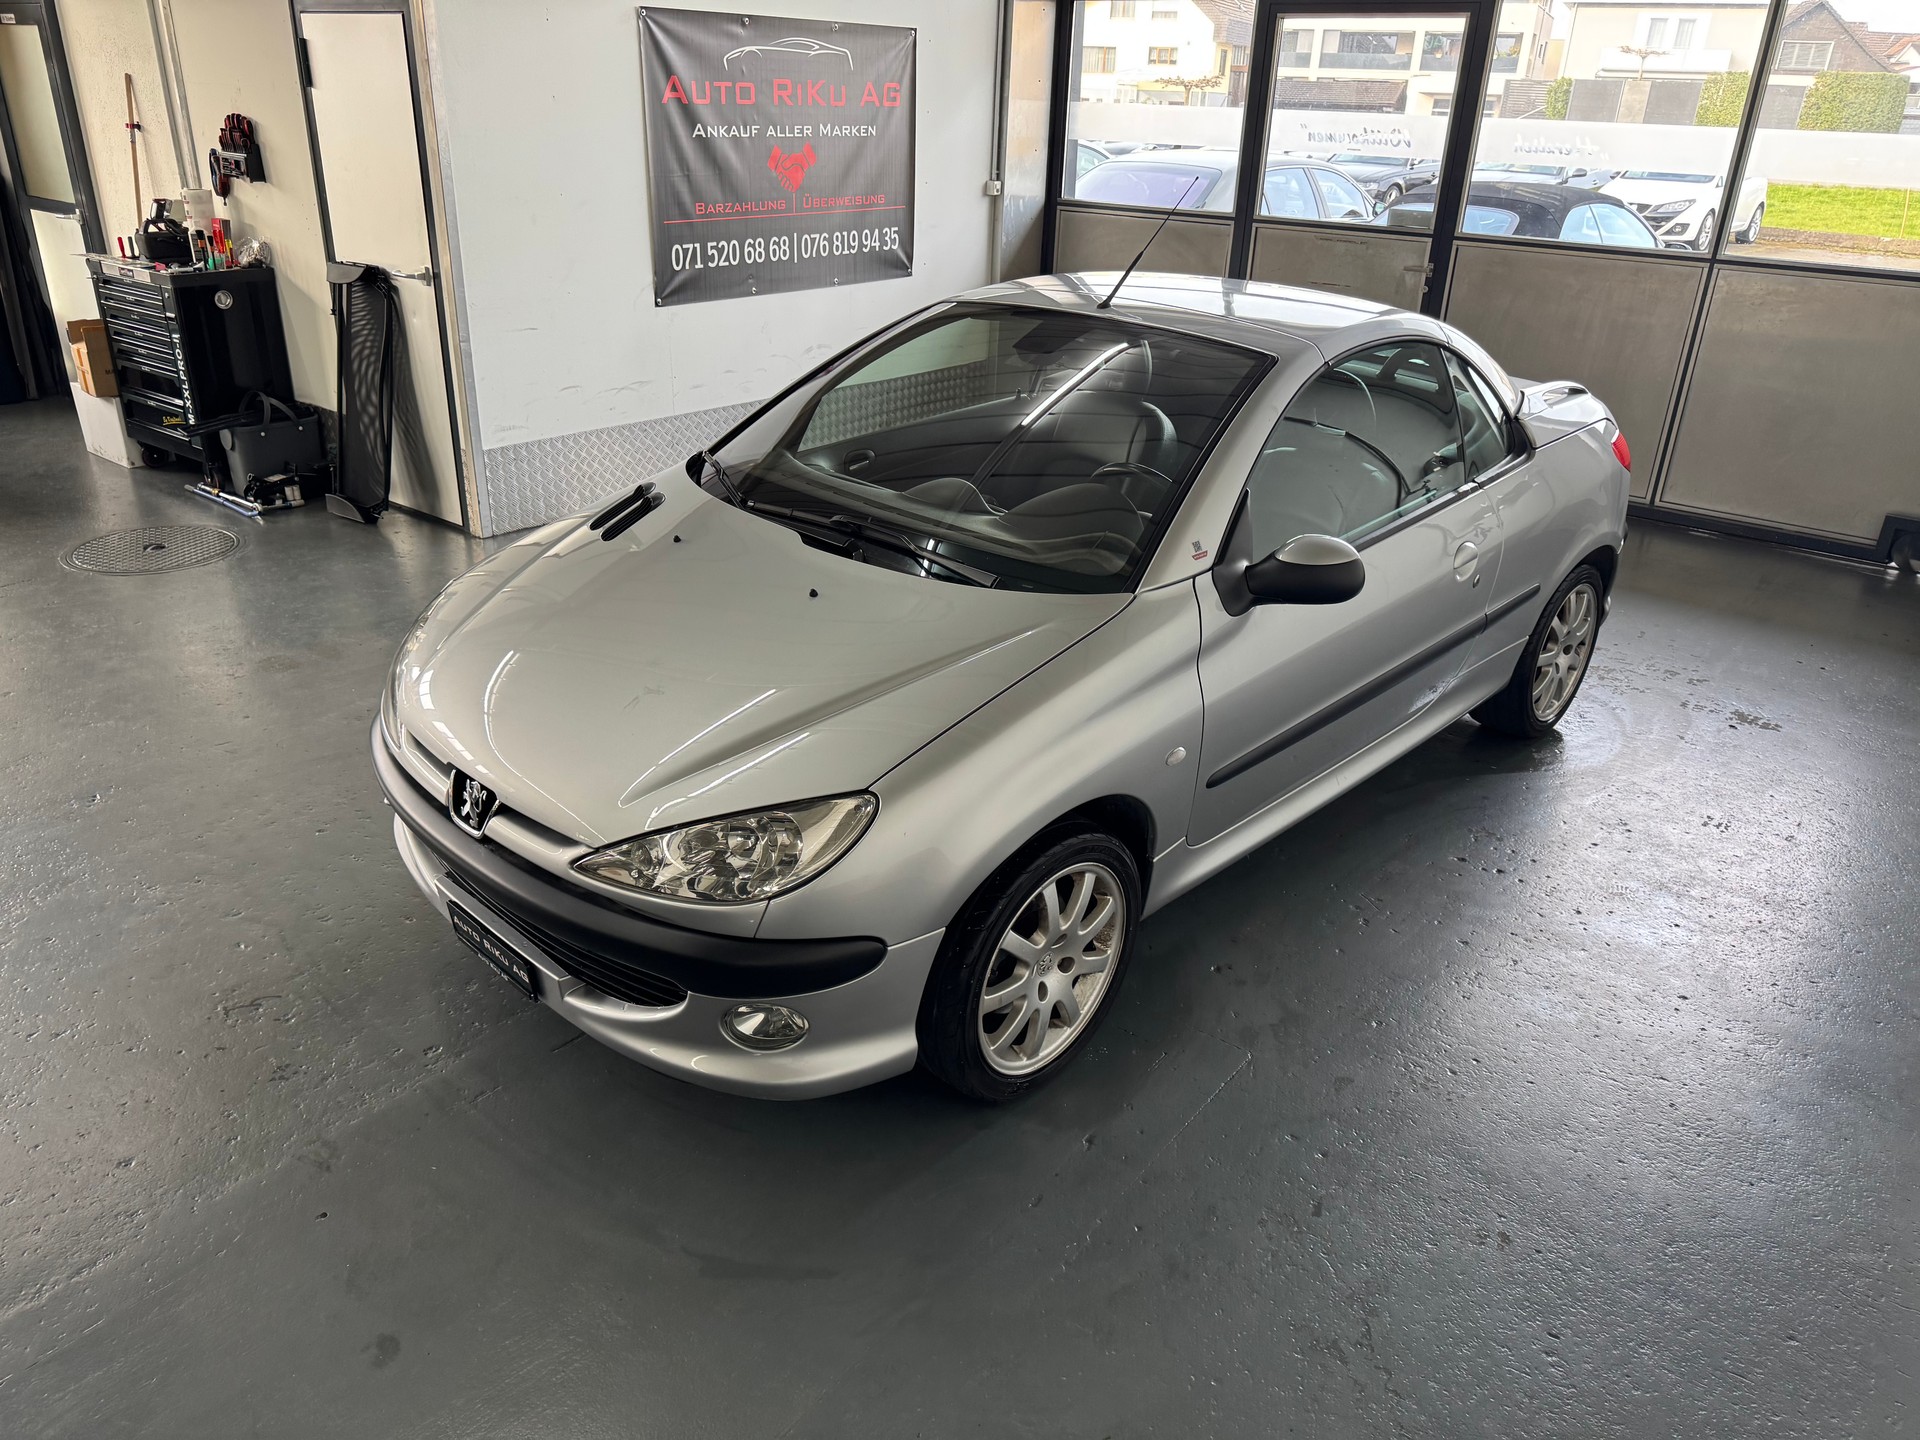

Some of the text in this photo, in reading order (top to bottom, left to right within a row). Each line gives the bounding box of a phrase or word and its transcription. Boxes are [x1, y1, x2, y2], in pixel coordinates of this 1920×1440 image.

[860, 81, 901, 107] AG
[766, 124, 813, 137] ALLER
[671, 226, 899, 271] 071 520 68 68 076 819 94 35
[453, 915, 481, 942] AUTO
